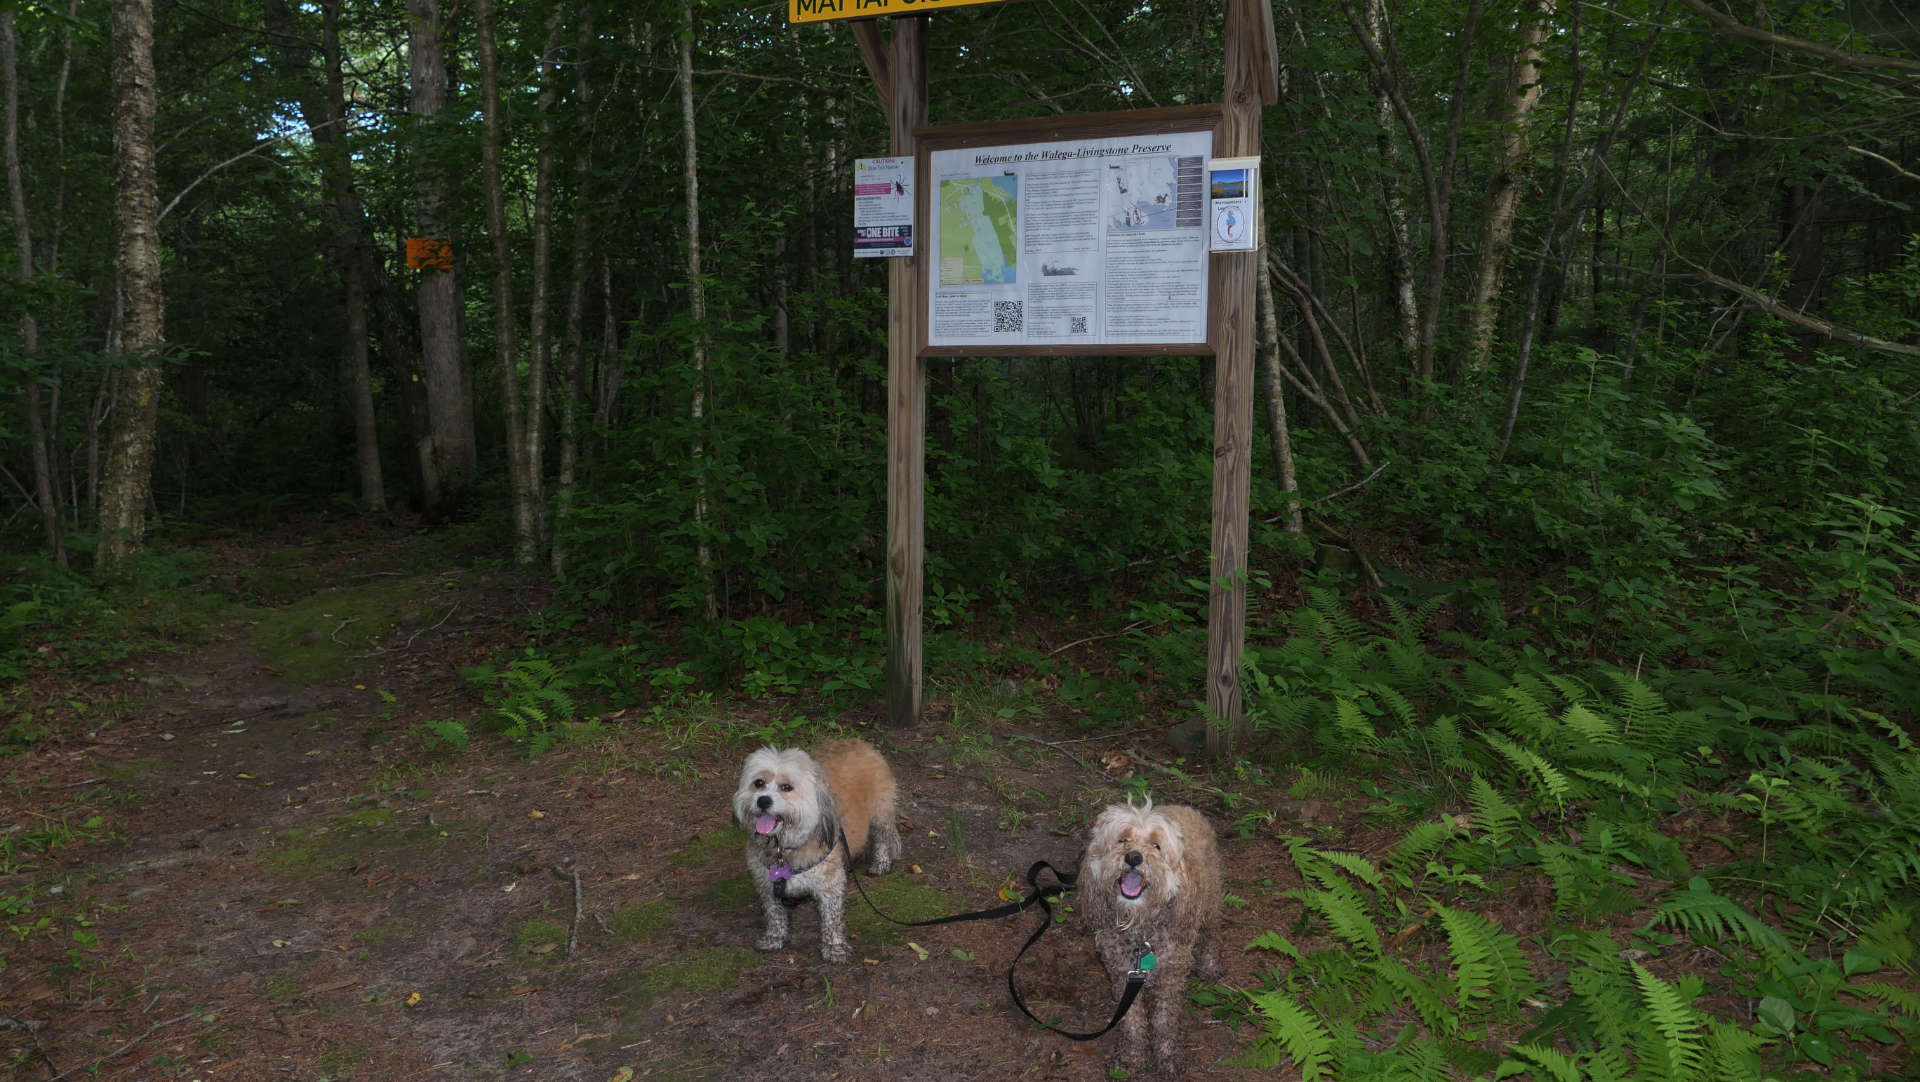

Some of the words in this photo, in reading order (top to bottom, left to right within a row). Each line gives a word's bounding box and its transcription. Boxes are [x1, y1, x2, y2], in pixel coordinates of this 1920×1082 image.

[975, 154, 1012, 164] Welcome
[1014, 153, 1023, 162] to
[1024, 151, 1039, 161] the
[1131, 144, 1172, 154] Preserve
[866, 227, 882, 238] ONE
[882, 226, 900, 237] BITE
